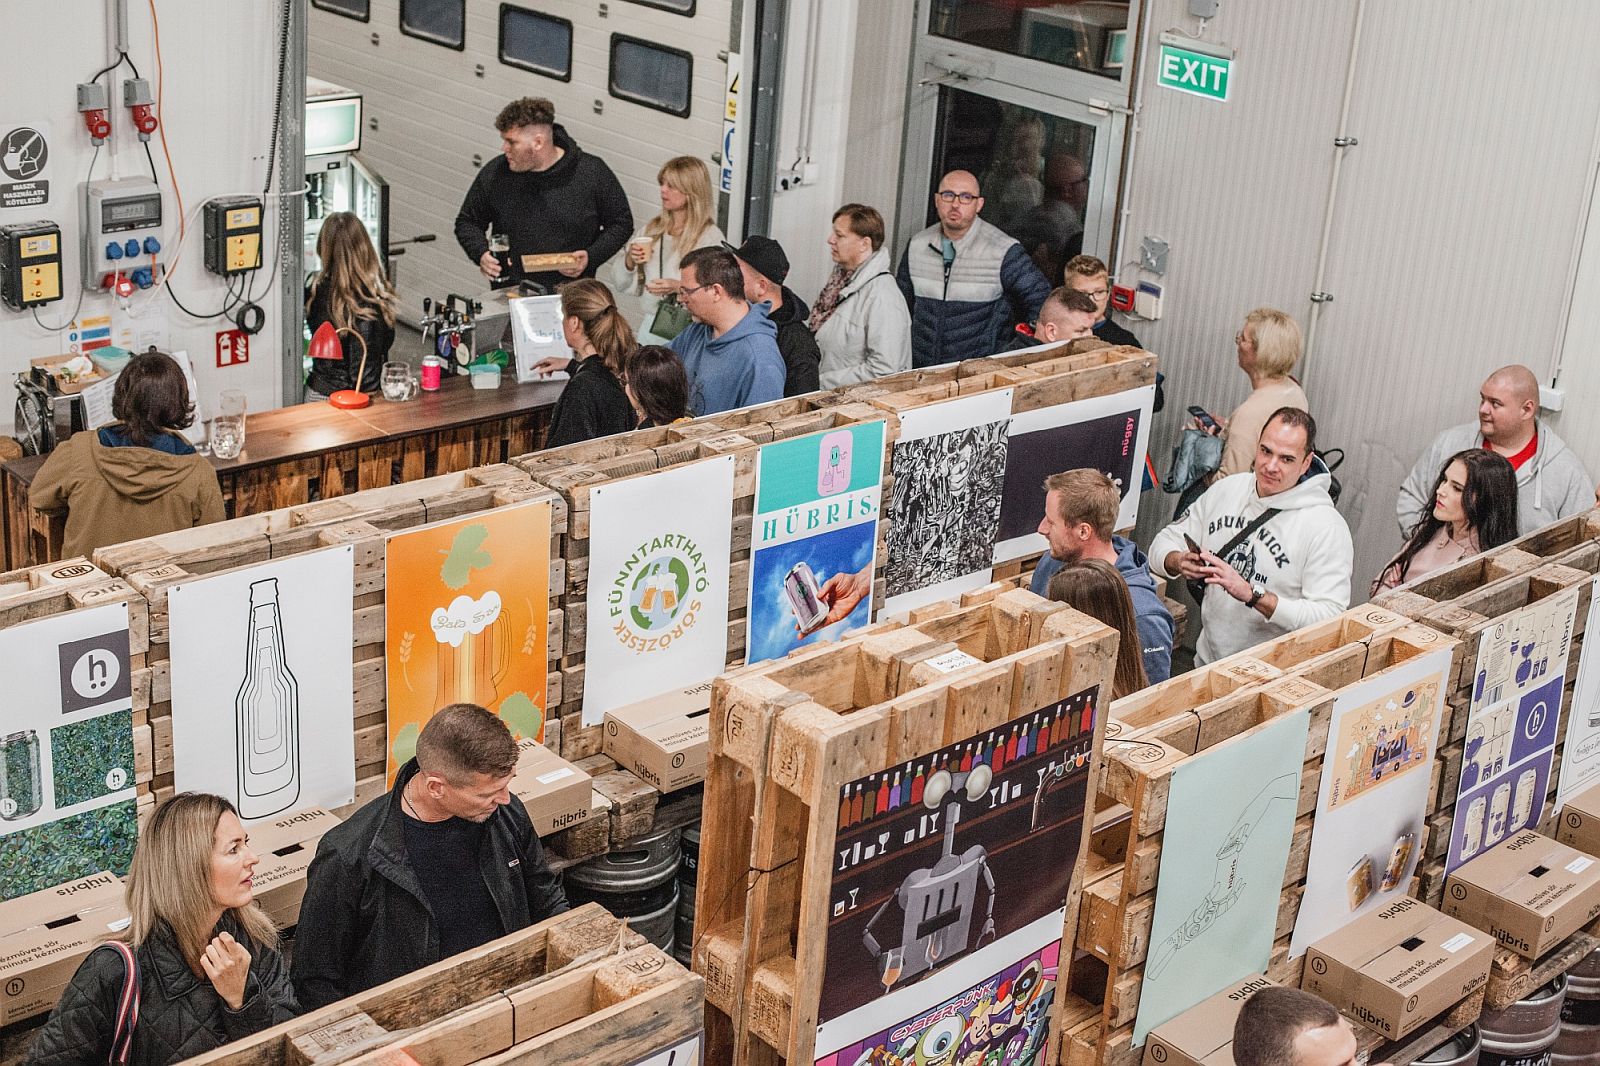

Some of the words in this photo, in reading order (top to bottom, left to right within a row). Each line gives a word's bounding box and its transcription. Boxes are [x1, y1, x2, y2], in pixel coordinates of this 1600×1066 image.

[1163, 54, 1227, 92] EXIT
[1121, 416, 1135, 456] müggy
[608, 534, 710, 617] FÜNNTARTHATÓ
[1255, 572, 1268, 584] BN
[613, 599, 702, 655] SÖRÖZÉSEK
[684, 683, 712, 695] bris
[0, 946, 42, 963] ézműves
